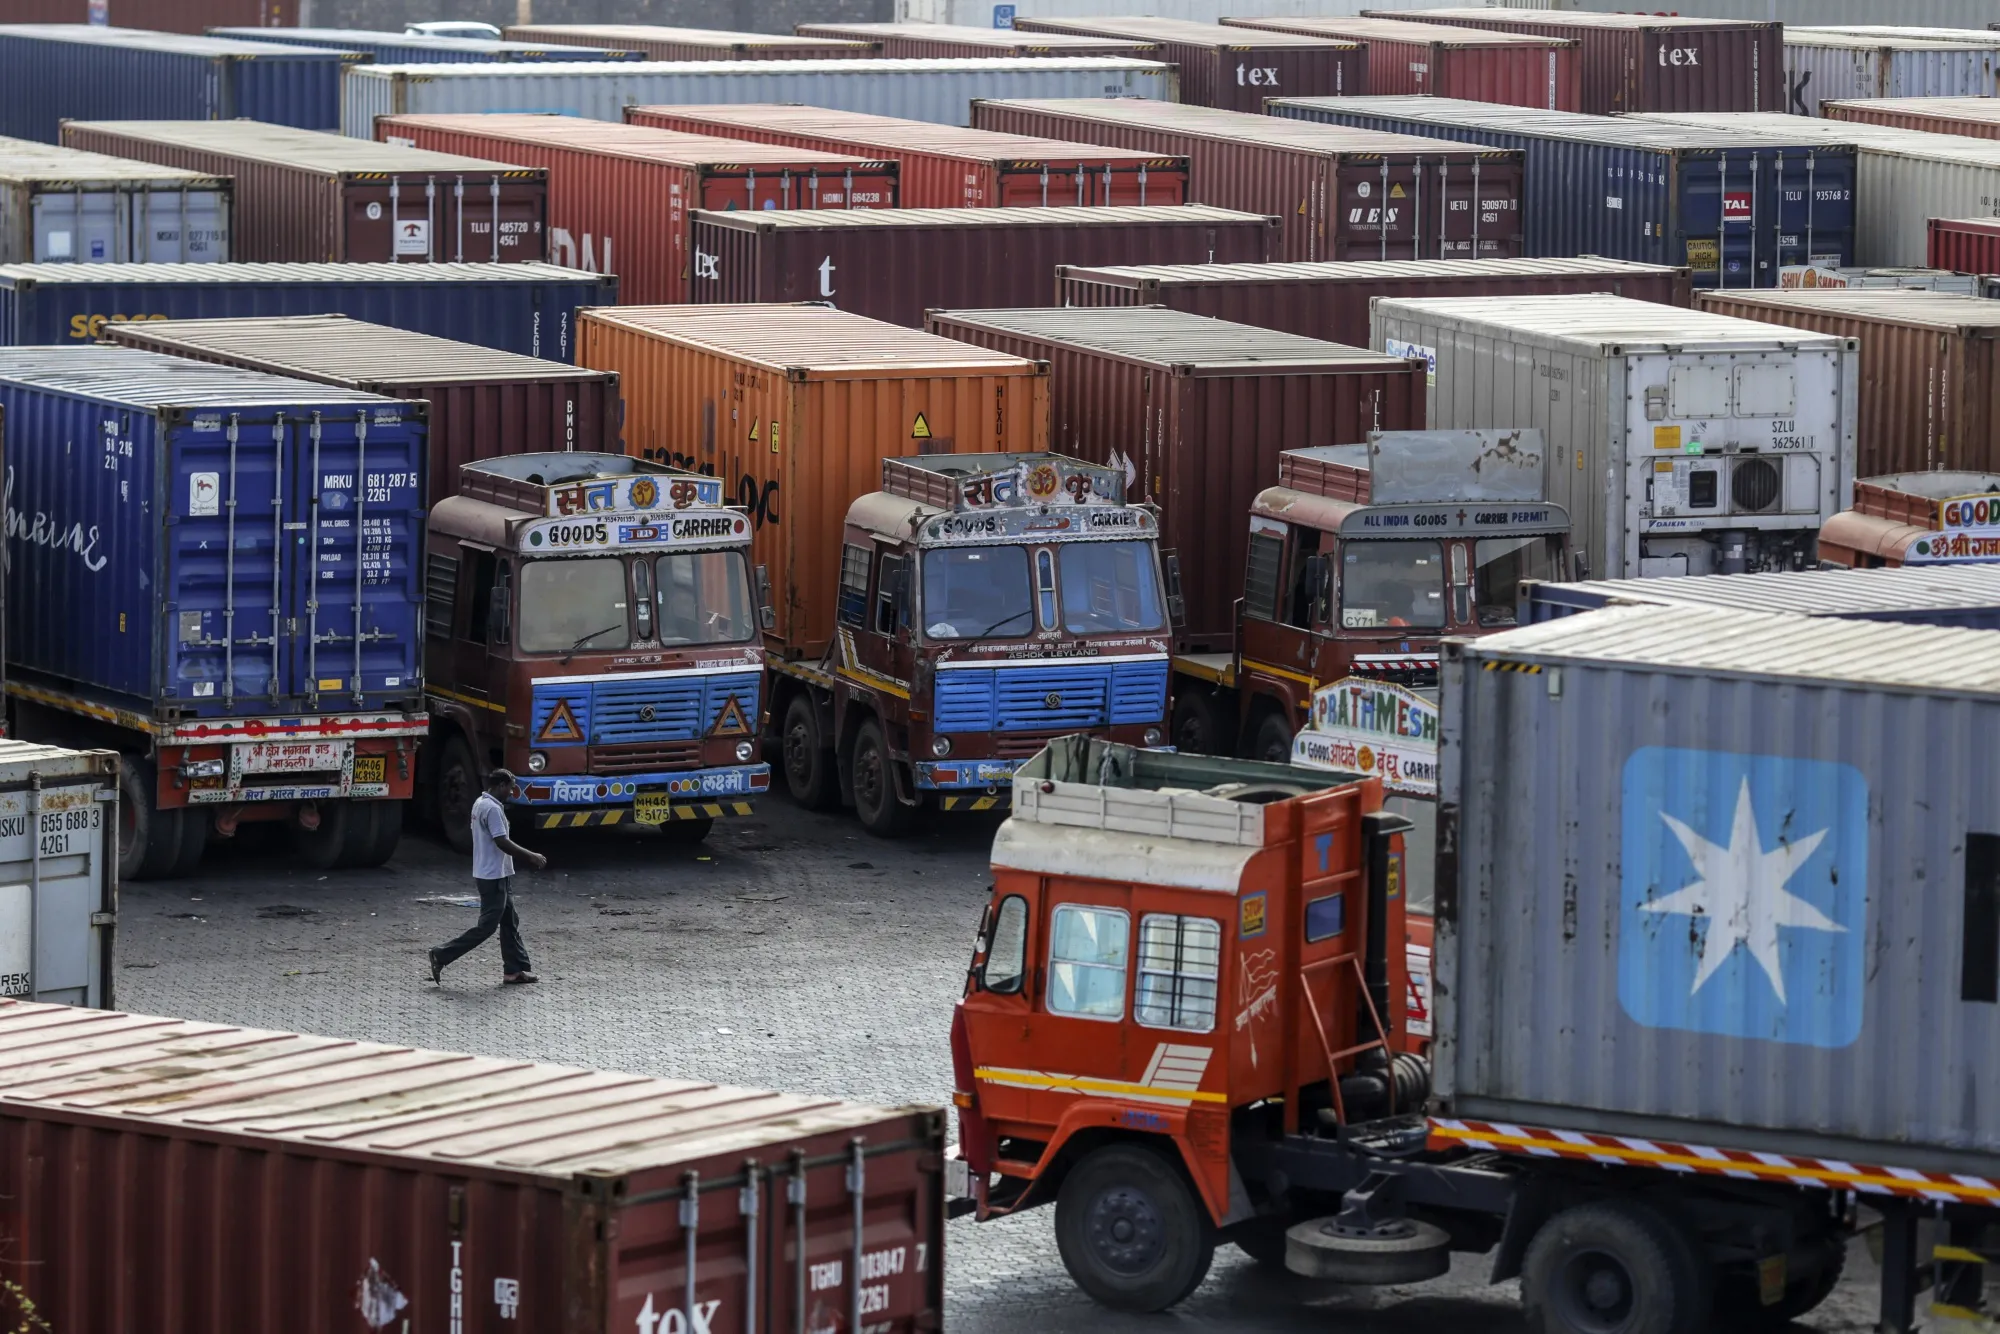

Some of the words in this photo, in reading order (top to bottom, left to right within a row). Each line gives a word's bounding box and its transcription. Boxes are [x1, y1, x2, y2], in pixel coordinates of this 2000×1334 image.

[1658, 43, 1698, 66] tex
[1236, 62, 1279, 86] tex
[852, 192, 880, 203] 664238
[1785, 191, 1802, 201] TCLU
[1816, 190, 1842, 201] 935768
[1450, 200, 1468, 211] UETU
[1482, 200, 1508, 210] 500970
[1724, 200, 1749, 210] TAL
[471, 222, 490, 233] TLLU
[499, 222, 528, 233] 485720
[1687, 241, 1718, 251] CAUTION
[1695, 252, 1712, 260] HIGH
[1688, 262, 1718, 270] TRAILER
[1772, 421, 1795, 432] SZLU
[1772, 436, 1806, 449] 362561
[324, 475, 352, 489] MRKU
[367, 474, 384, 488] 681
[388, 474, 407, 487] 287
[411, 474, 417, 487] 5
[367, 488, 391, 502] 22G1
[555, 480, 618, 516] संत
[335, 520, 350, 528] GROSS
[1364, 515, 1381, 527] ALL
[1383, 514, 1409, 526] INDIA
[1414, 514, 1448, 526] GOODS
[1475, 512, 1508, 525] CARRIER
[1512, 511, 1549, 523] PERMIT
[549, 523, 608, 545] GOODS
[672, 516, 732, 539] CARRIER
[384, 536, 392, 544] KG
[321, 554, 341, 562] PAYLOAD
[322, 571, 334, 579] CUBE
[367, 570, 378, 578] 33.2
[1345, 616, 1374, 627] CY71
[1008, 651, 1044, 659] ASHOK
[1050, 649, 1098, 657] LEYLAND
[1318, 687, 1437, 740] PRATHMESH
[553, 780, 596, 802] विजय
[644, 808, 669, 820] 5175
[41, 813, 63, 833] 655
[66, 810, 88, 830] 688
[92, 808, 100, 828] 3
[41, 834, 69, 855] 42G1
[810, 1261, 842, 1291] TGHU
